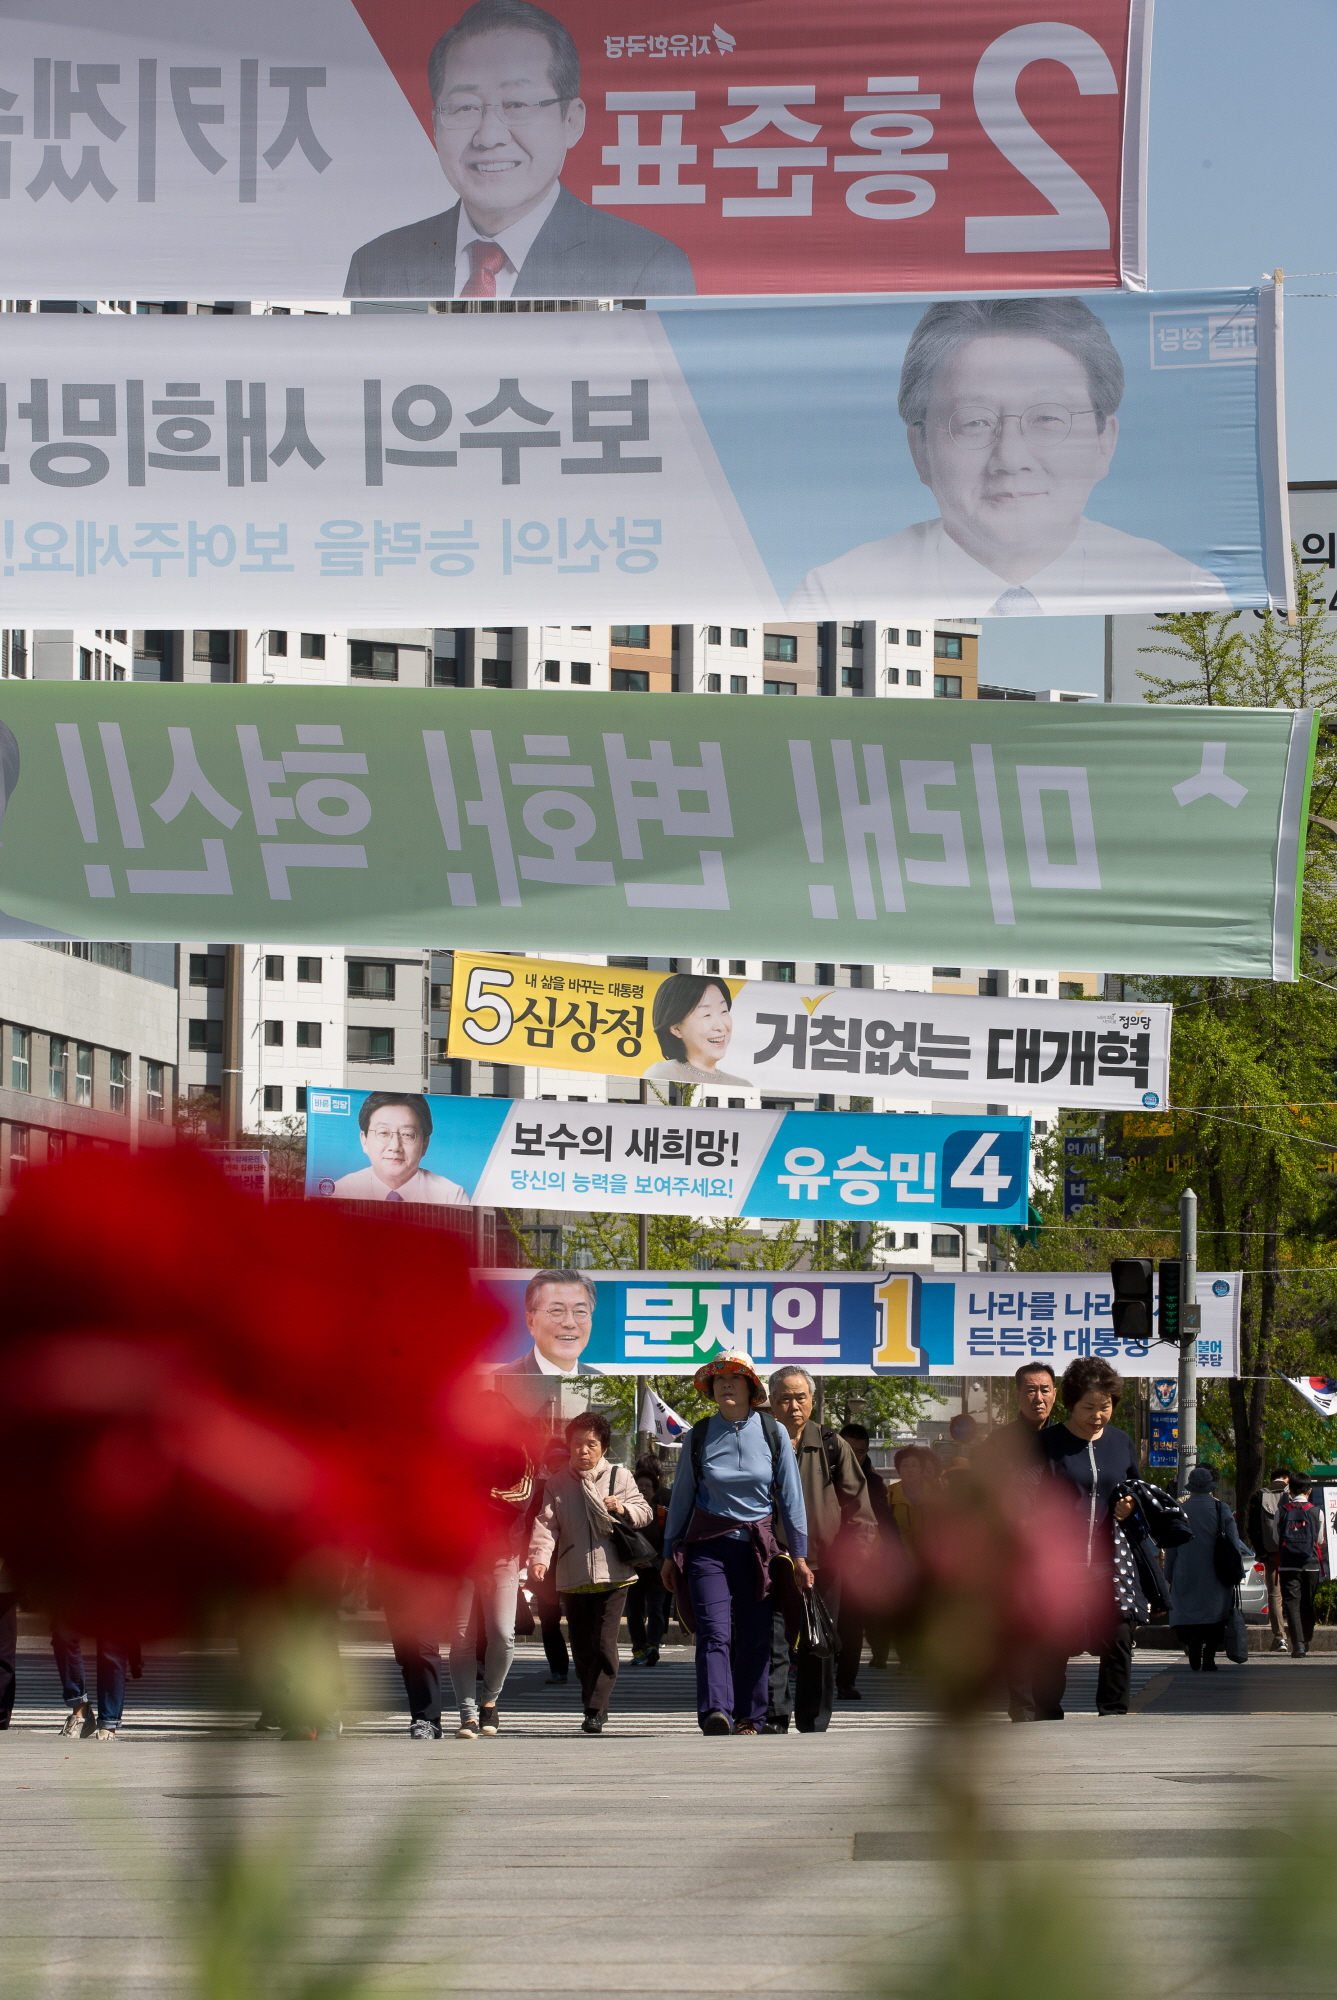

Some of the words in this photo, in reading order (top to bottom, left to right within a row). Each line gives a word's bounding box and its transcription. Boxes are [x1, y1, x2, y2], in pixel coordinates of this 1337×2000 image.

[525, 973, 537, 988] 내
[540, 975, 566, 991] 삶을
[568, 978, 605, 995] 바꾸는
[608, 982, 645, 999] 대통령
[462, 966, 514, 1045] 5
[513, 996, 645, 1058] 심상정
[1118, 1015, 1152, 1030] 정의당
[753, 1012, 972, 1081] 거침없는
[986, 1027, 1151, 1089] 대개혁
[510, 1122, 613, 1163] 보수의
[624, 1126, 740, 1168] 새희망!
[510, 1169, 566, 1192] 당신의
[572, 1171, 629, 1195] 능력을
[634, 1174, 734, 1199] 보여주세요!
[777, 1145, 937, 1206] 유승민
[950, 1132, 1013, 1203] 4
[968, 1291, 1057, 1322] 나라를
[624, 1287, 841, 1359] 문재인
[872, 1272, 927, 1373] 1
[966, 1326, 1057, 1356] 든든한
[1195, 1340, 1222, 1354] 불어
[1195, 1353, 1223, 1368] 주당
